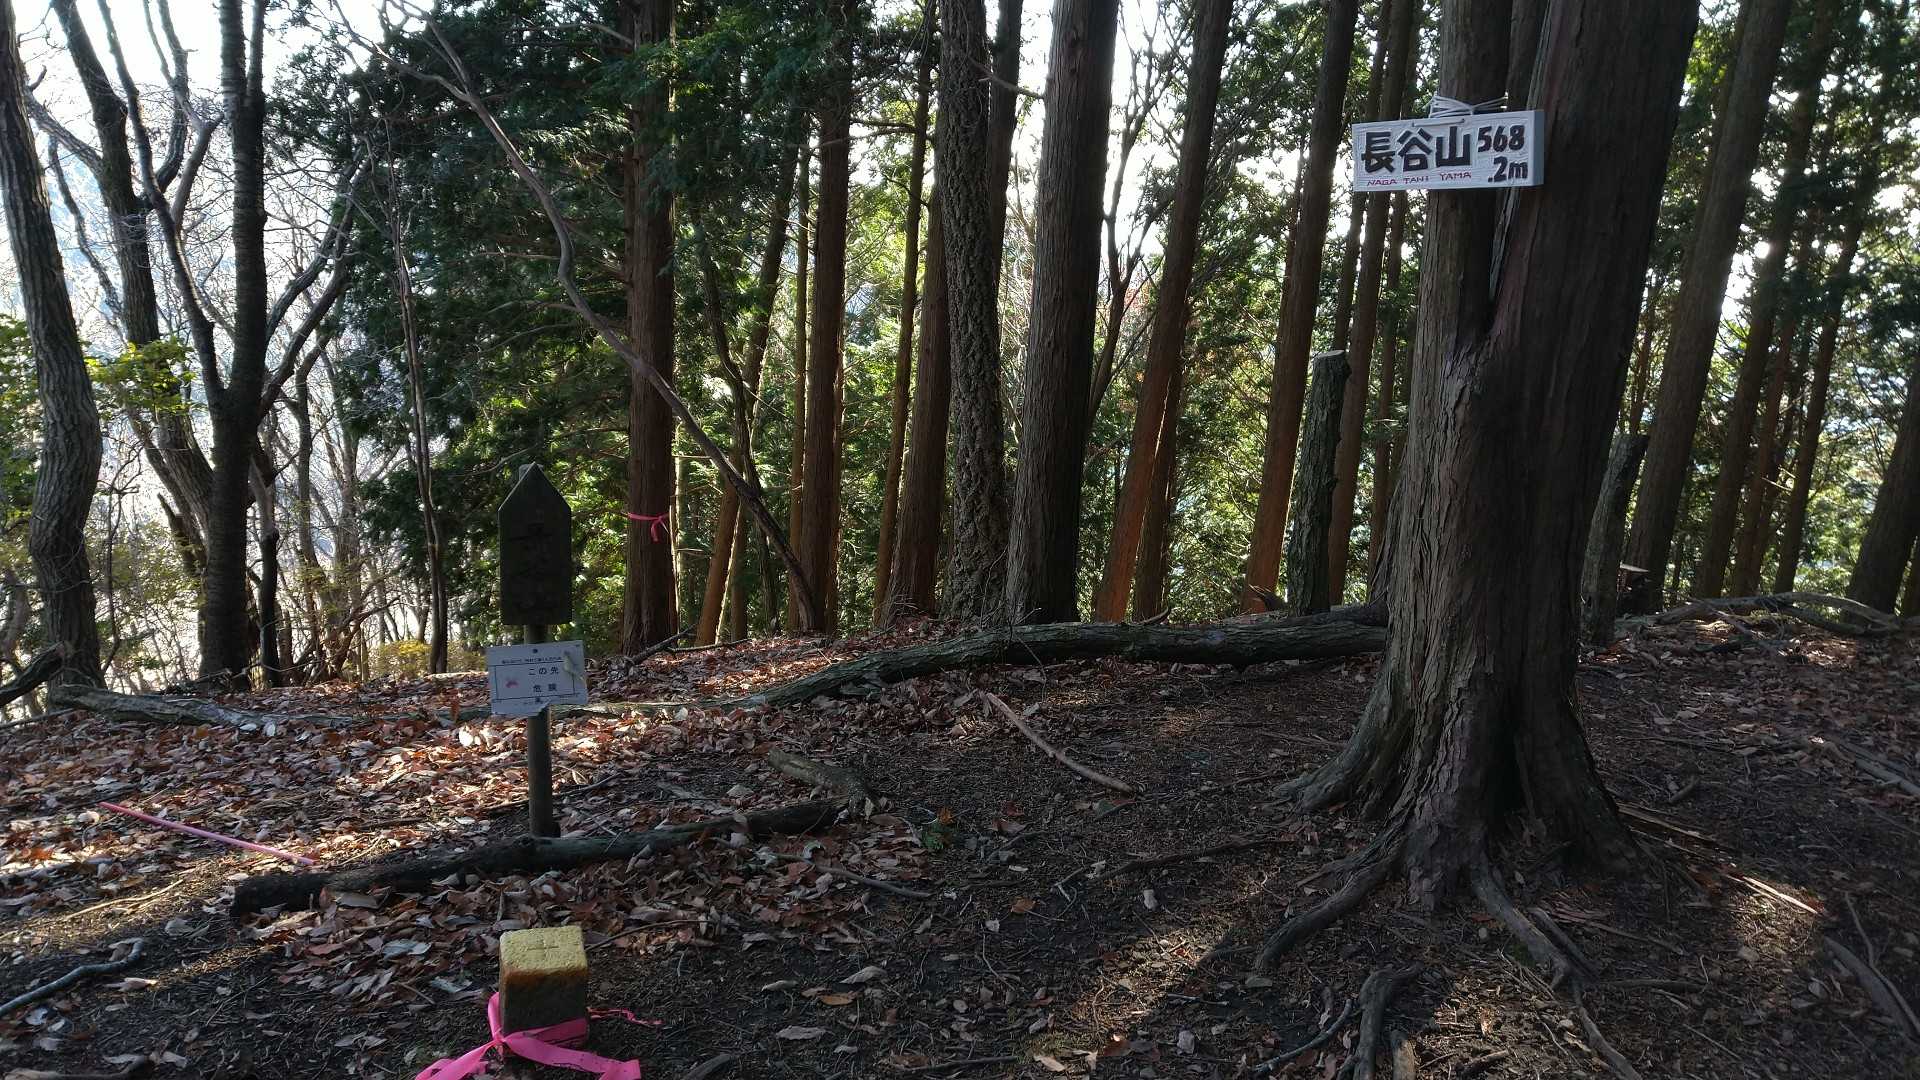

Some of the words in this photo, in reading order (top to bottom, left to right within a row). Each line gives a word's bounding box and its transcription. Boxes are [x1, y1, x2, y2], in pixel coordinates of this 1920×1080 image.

[1361, 126, 1471, 173] 長谷山
[1478, 125, 1525, 152] 568
[1367, 178, 1397, 186] NAGA
[1403, 176, 1429, 184] TANI
[1440, 172, 1472, 181] YAMA
[1488, 156, 1528, 182] .2m
